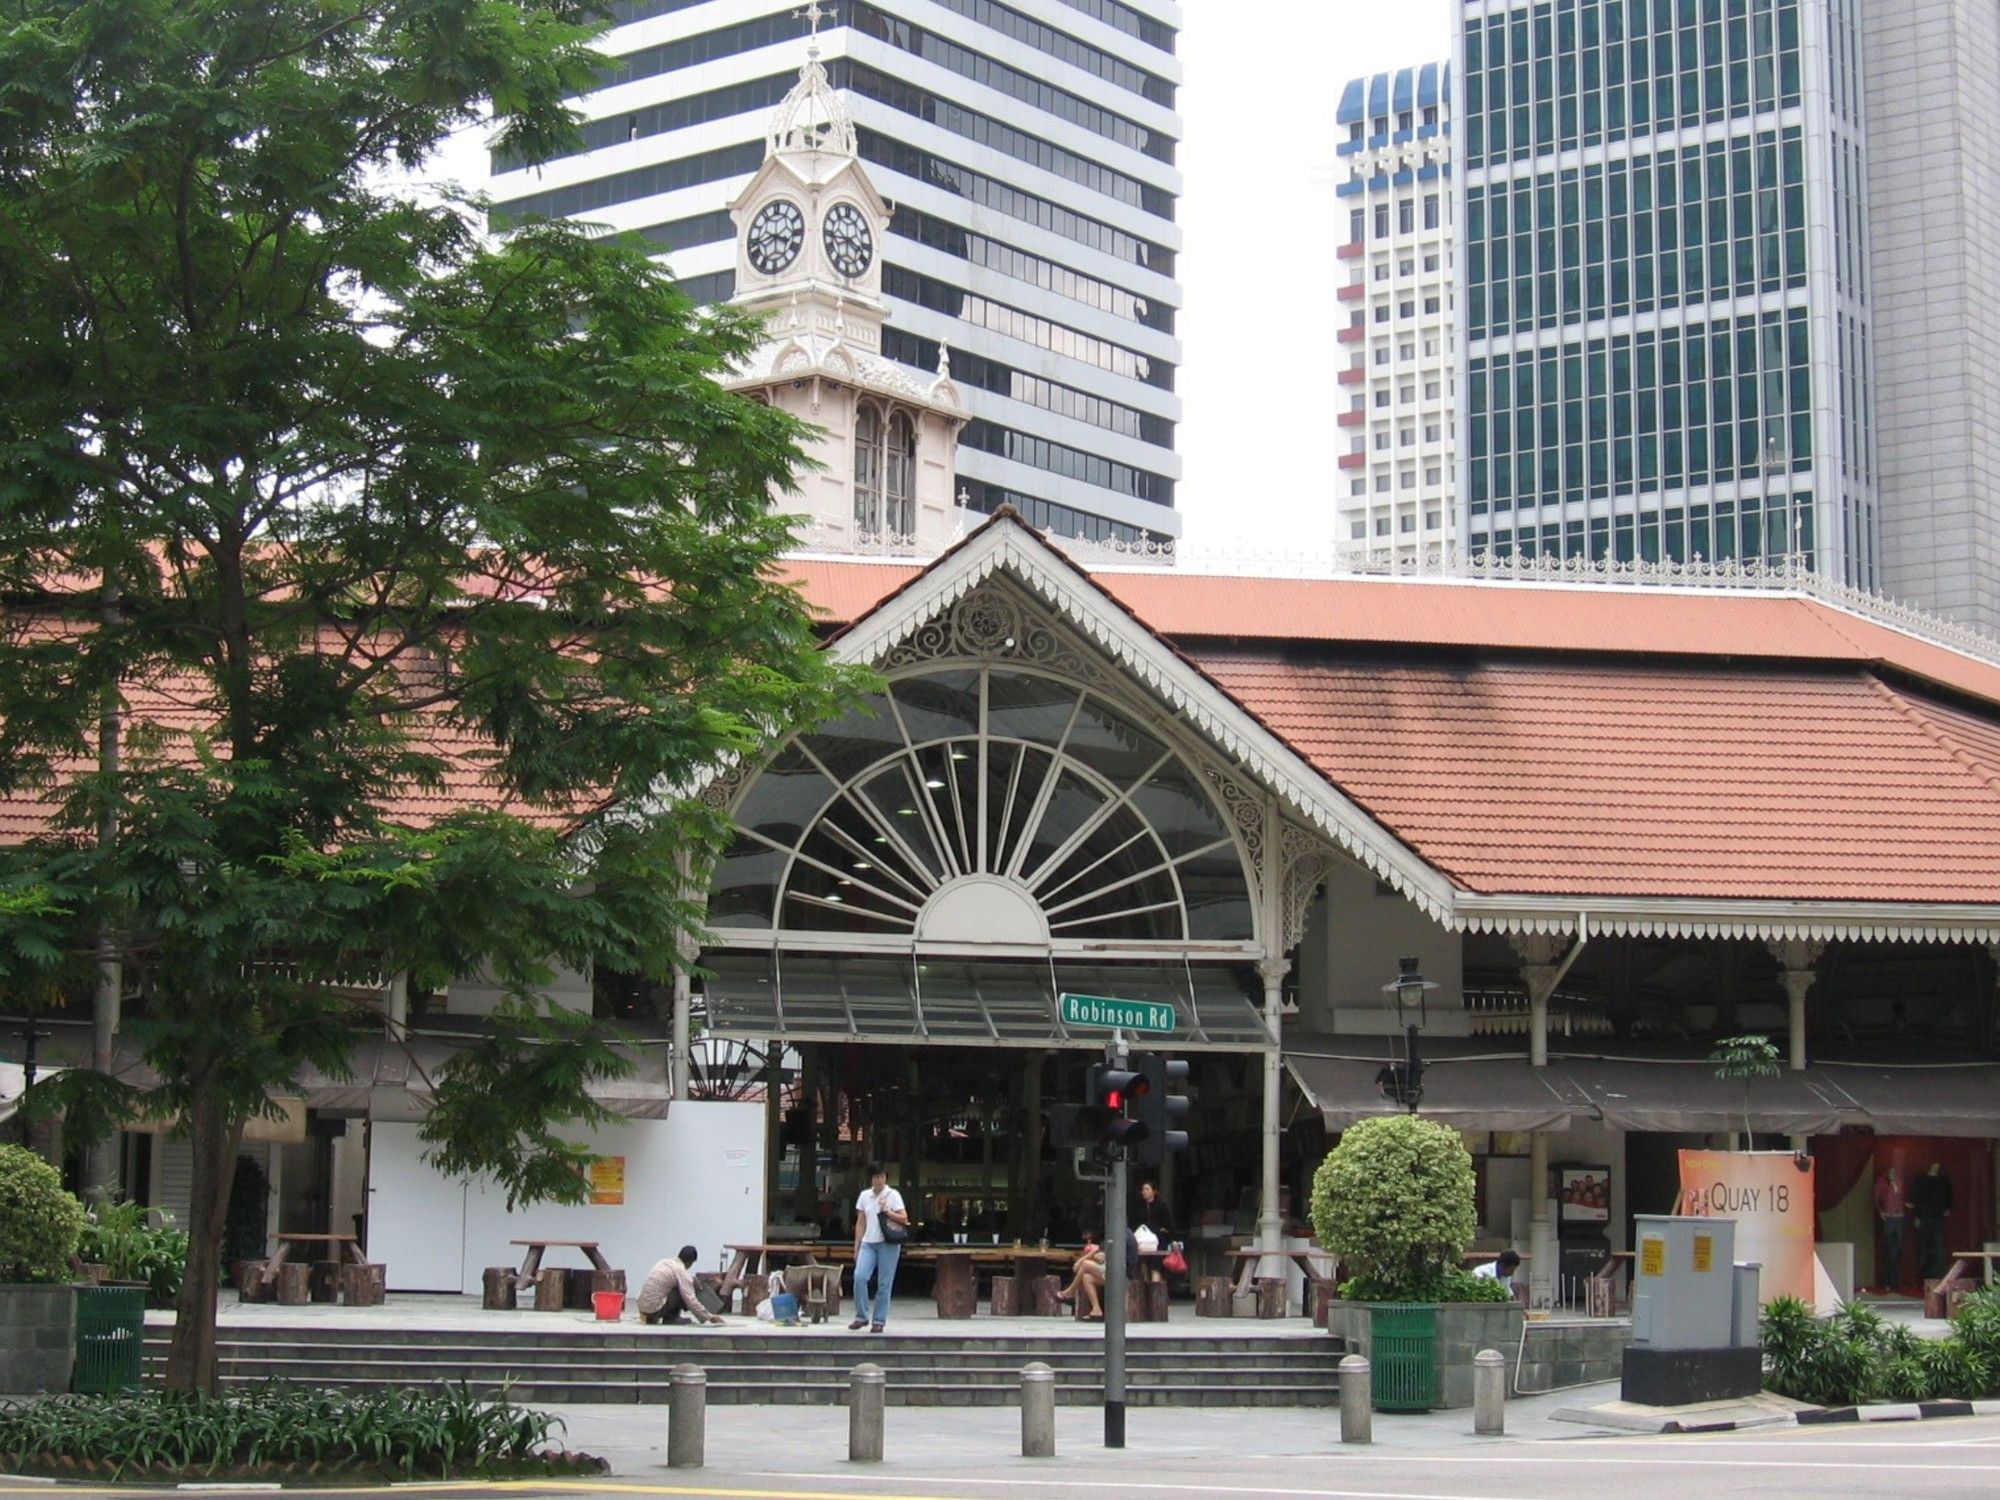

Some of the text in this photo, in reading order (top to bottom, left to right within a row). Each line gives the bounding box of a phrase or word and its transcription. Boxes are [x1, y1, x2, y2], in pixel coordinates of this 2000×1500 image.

[1070, 999, 1168, 1028] Robinson Rd
[1711, 1182, 1789, 1213] QUAY 18
